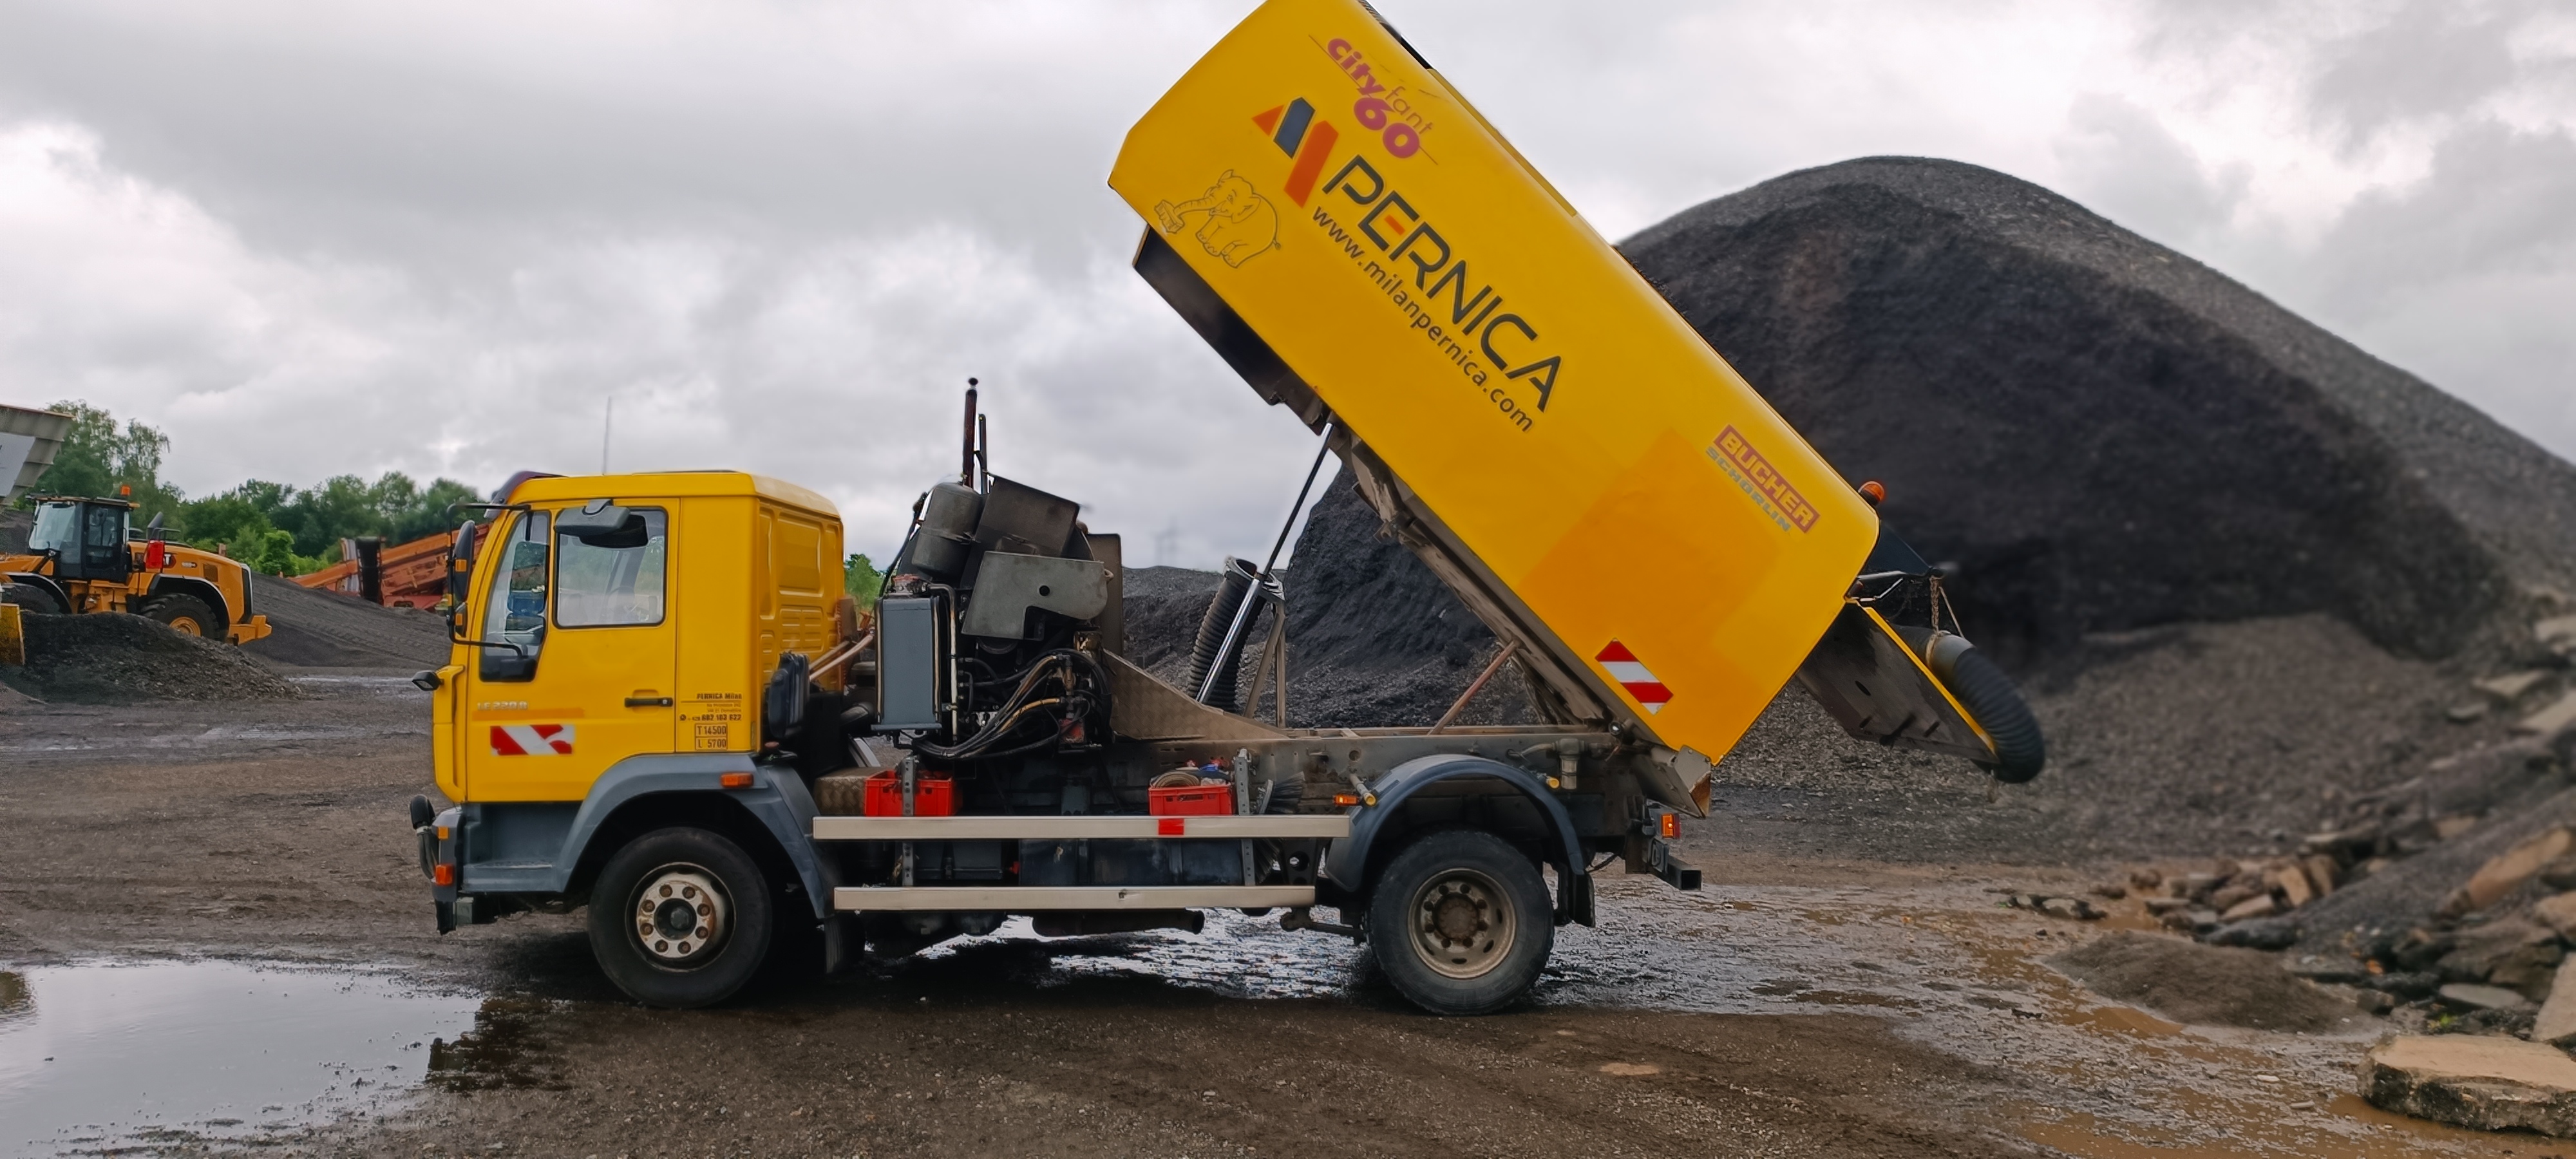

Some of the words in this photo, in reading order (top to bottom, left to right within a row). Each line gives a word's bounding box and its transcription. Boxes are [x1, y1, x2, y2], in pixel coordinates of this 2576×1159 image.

[1327, 38, 1386, 95] city
[1385, 86, 1434, 134] fant
[1354, 97, 1420, 158] 60
[1312, 205, 1534, 433] www.milanpernica.com
[1322, 154, 1562, 413] PERNICA
[1719, 431, 1815, 527] BUCHER
[697, 726, 702, 735] T
[704, 725, 726, 735] 14500
[698, 739, 703, 748] L
[707, 738, 726, 748] 5700
